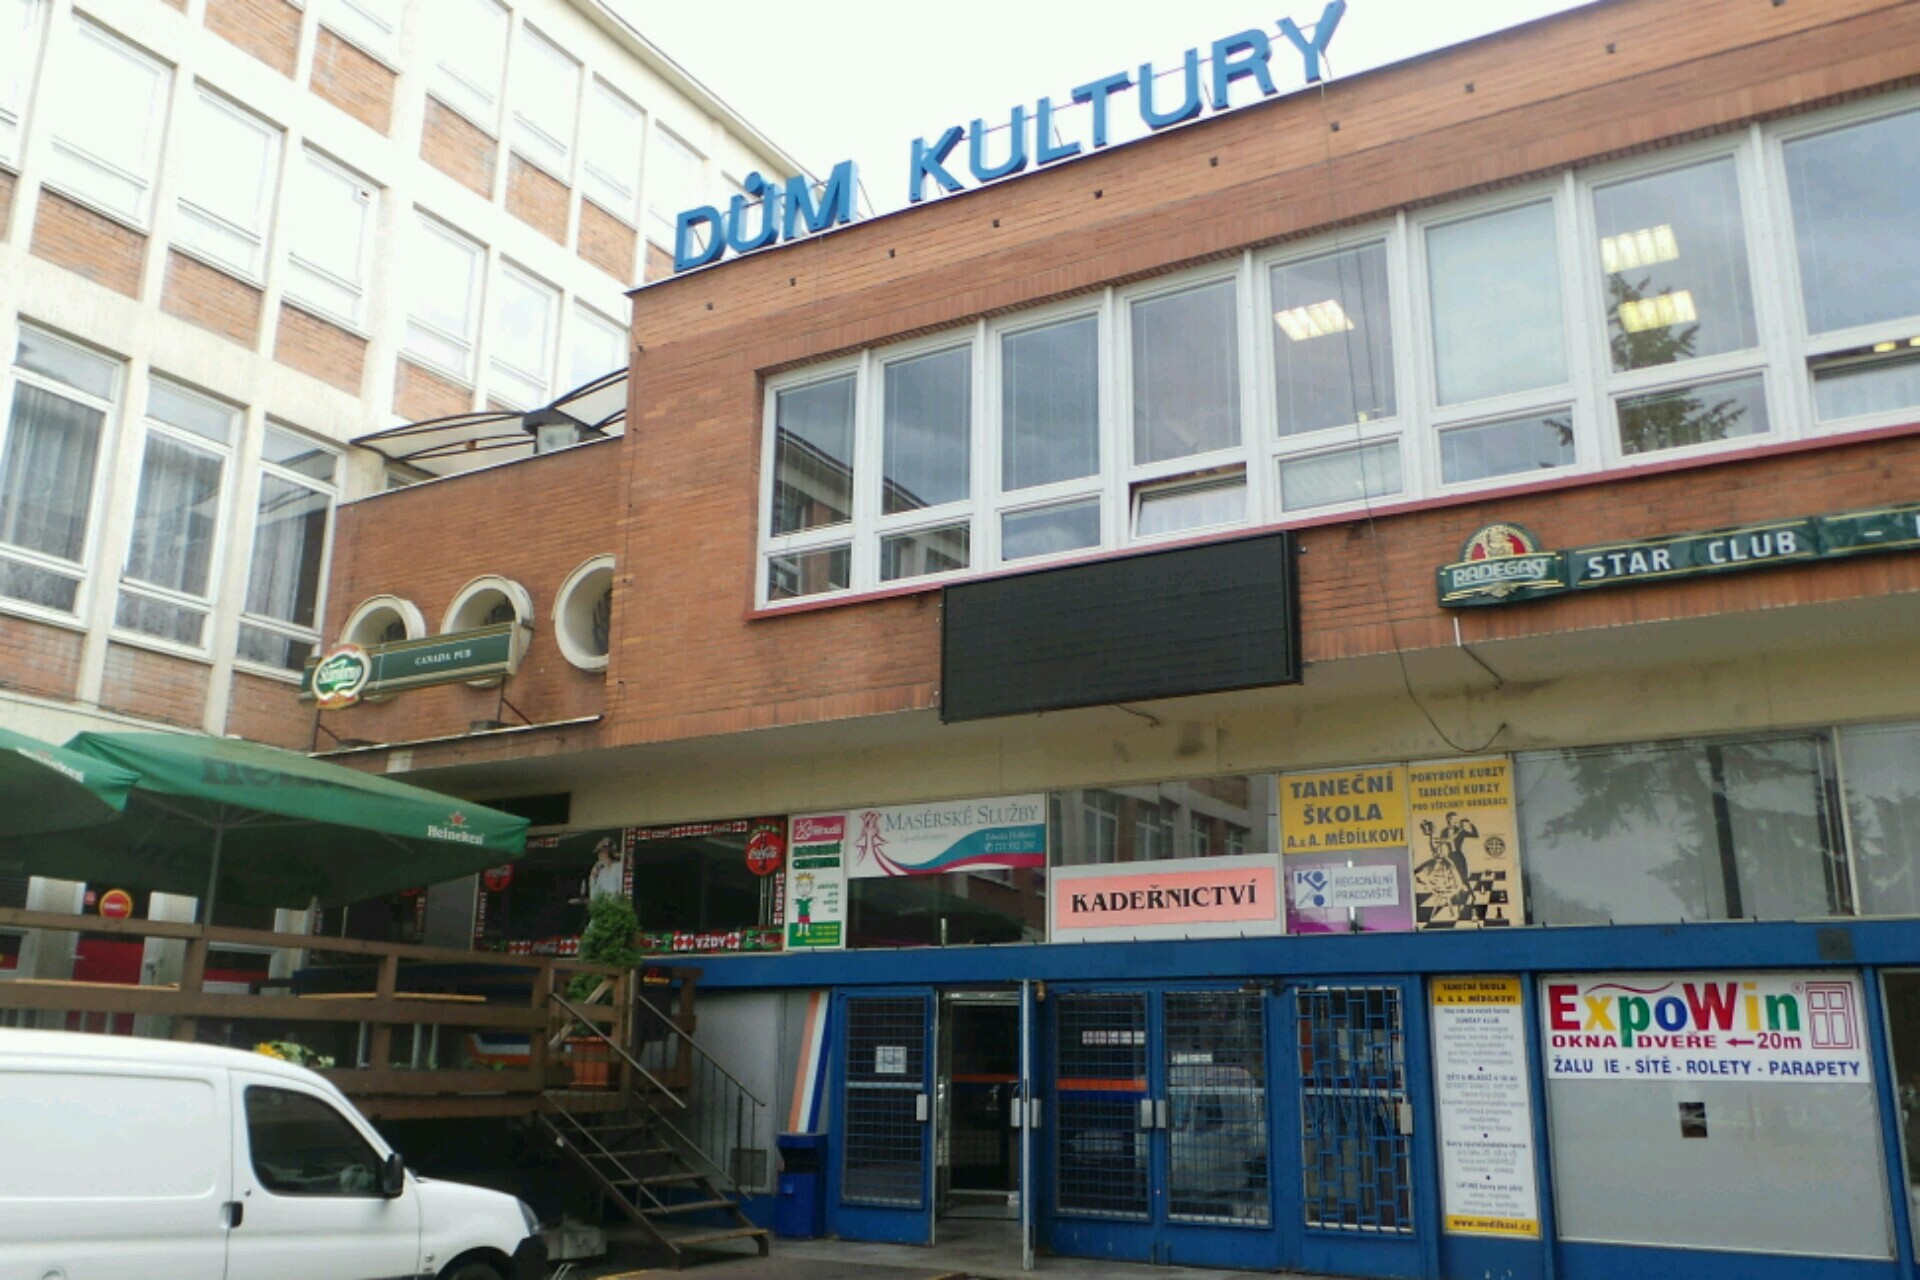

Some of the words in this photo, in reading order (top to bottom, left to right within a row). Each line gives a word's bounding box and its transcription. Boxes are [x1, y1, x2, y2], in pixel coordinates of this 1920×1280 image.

[674, 160, 858, 273] DŮM
[910, 0, 1346, 202] KULTURY
[1588, 548, 1670, 579] STAR
[1708, 530, 1797, 564] CLUB
[1452, 557, 1549, 588] RADEGAST
[415, 653, 450, 665] CANADA
[454, 649, 471, 660] PUB
[1411, 767, 1465, 783] POHYBOVÉ
[1469, 765, 1506, 778] KURZY
[1291, 771, 1394, 799] TANEČNÍ
[1418, 783, 1461, 797] TANEČNÍ
[1463, 783, 1500, 795] KURZY
[1303, 803, 1383, 825] ŠKOLA
[1412, 803, 1428, 812] PRO
[1467, 797, 1508, 807] GENERACE
[427, 825, 484, 845] Heineken
[1325, 826, 1405, 846] MĚDÍLKOVI
[1335, 873, 1393, 888] REGIONÁLNÍ
[1072, 879, 1257, 913] KADEŘNICTVÍ
[1336, 887, 1392, 900] PRACOVIŠTĚ
[695, 935, 726, 949] VŽDY
[1548, 981, 1801, 1047] ExpoWin
[1552, 1035, 1617, 1048] OKNA
[1638, 1031, 1717, 1048] DVEŘE
[1757, 1033, 1802, 1049] 20m
[1635, 1056, 1671, 1074] SÍTĚ
[1687, 1060, 1751, 1075] ROLETY
[1769, 1061, 1860, 1076] PARAPETY
